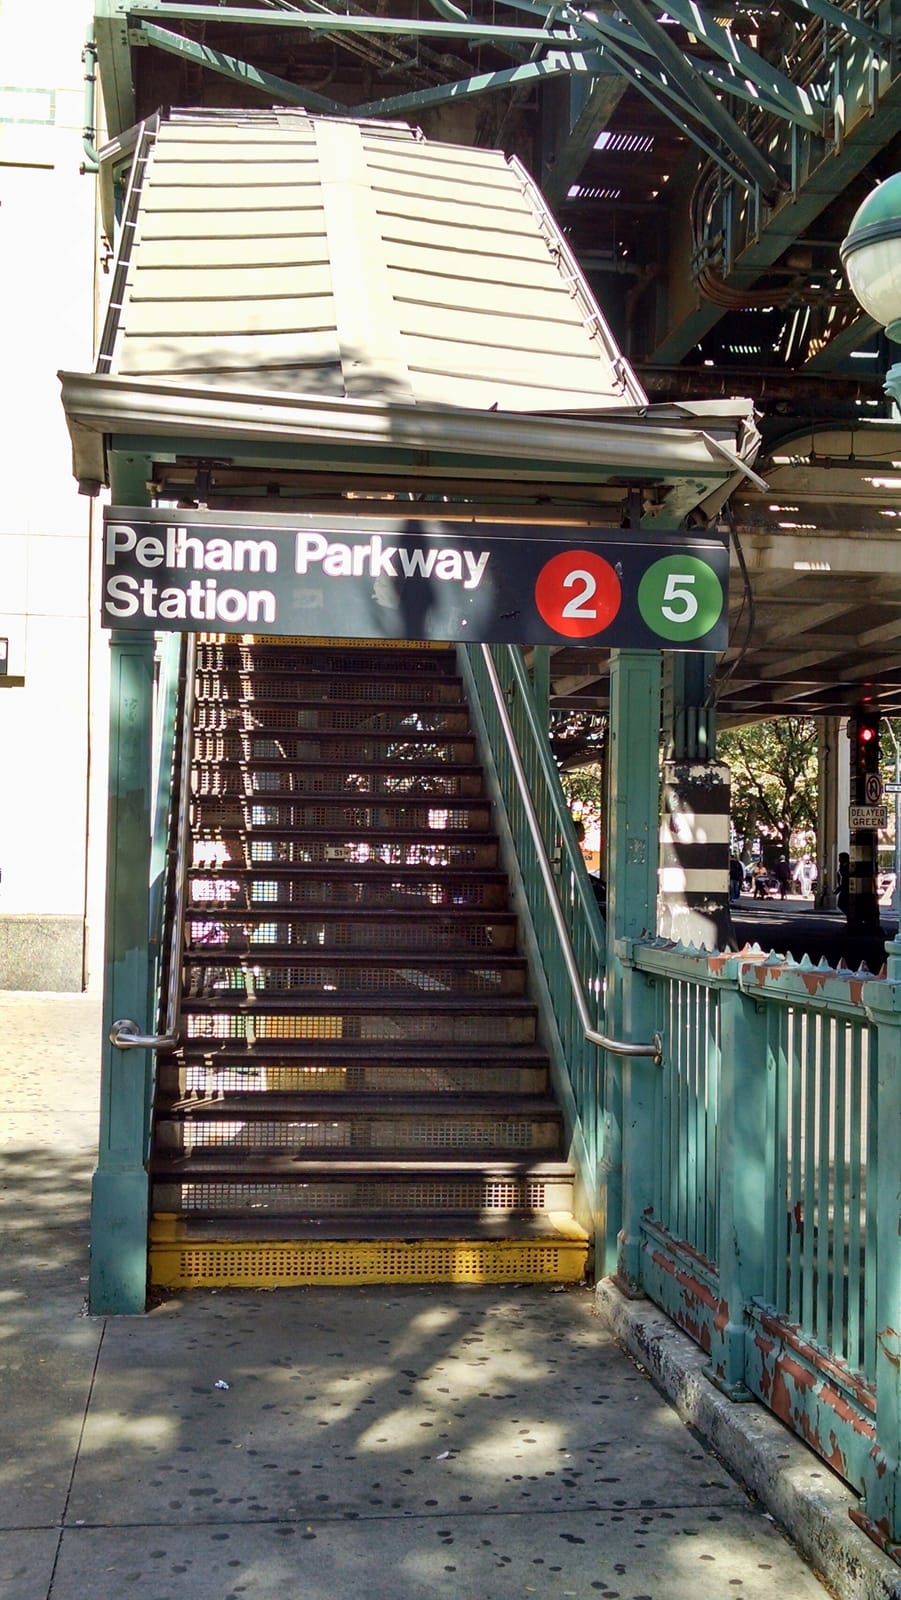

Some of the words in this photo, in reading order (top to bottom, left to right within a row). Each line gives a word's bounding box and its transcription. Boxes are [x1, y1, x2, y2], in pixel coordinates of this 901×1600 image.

[106, 526, 277, 573] Pelham
[295, 532, 490, 589] Parkway
[105, 574, 276, 623] Station
[562, 569, 597, 619] 2
[661, 574, 698, 623] 5
[852, 818, 885, 826] GREEN
